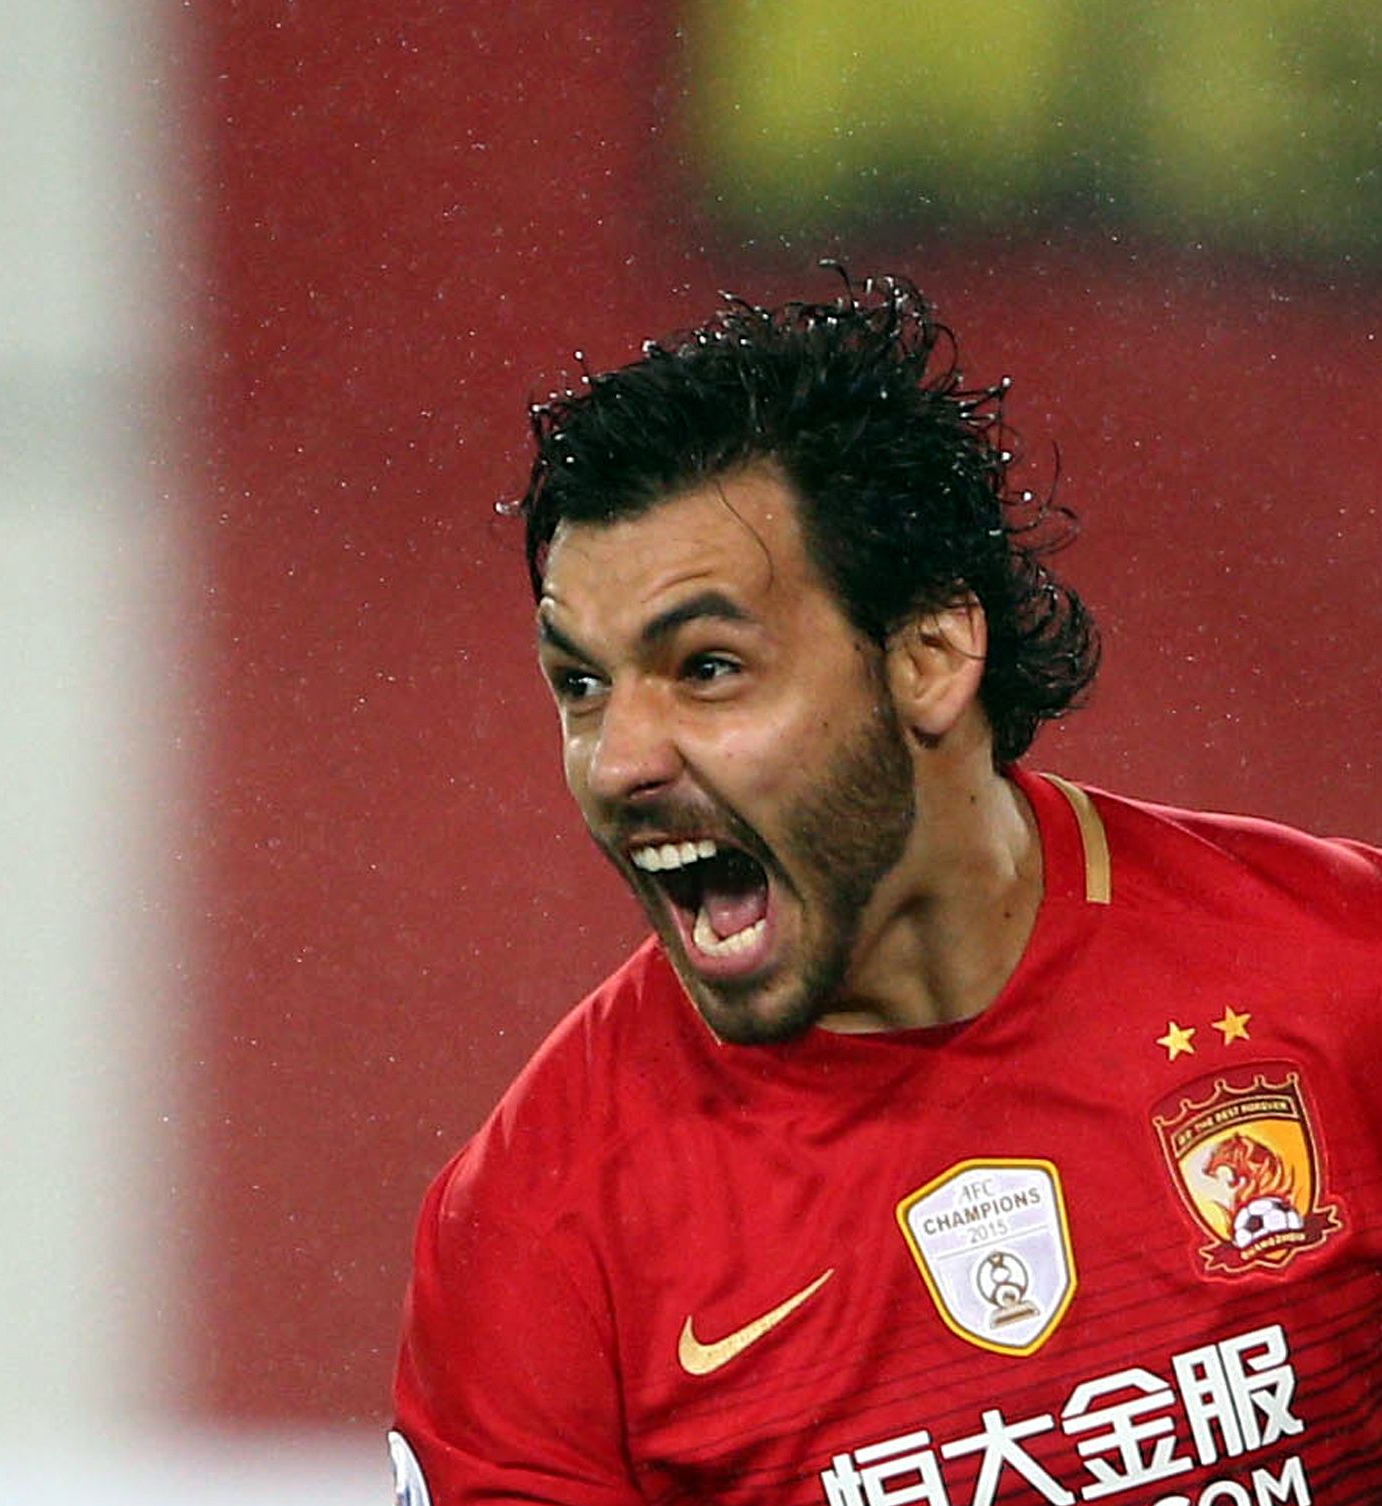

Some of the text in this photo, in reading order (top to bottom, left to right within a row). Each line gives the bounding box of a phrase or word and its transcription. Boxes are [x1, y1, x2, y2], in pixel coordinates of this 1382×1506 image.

[958, 1178, 995, 1205] AFC
[923, 1187, 1041, 1235] CHAMPIONS
[967, 1219, 1008, 1244] 2015
